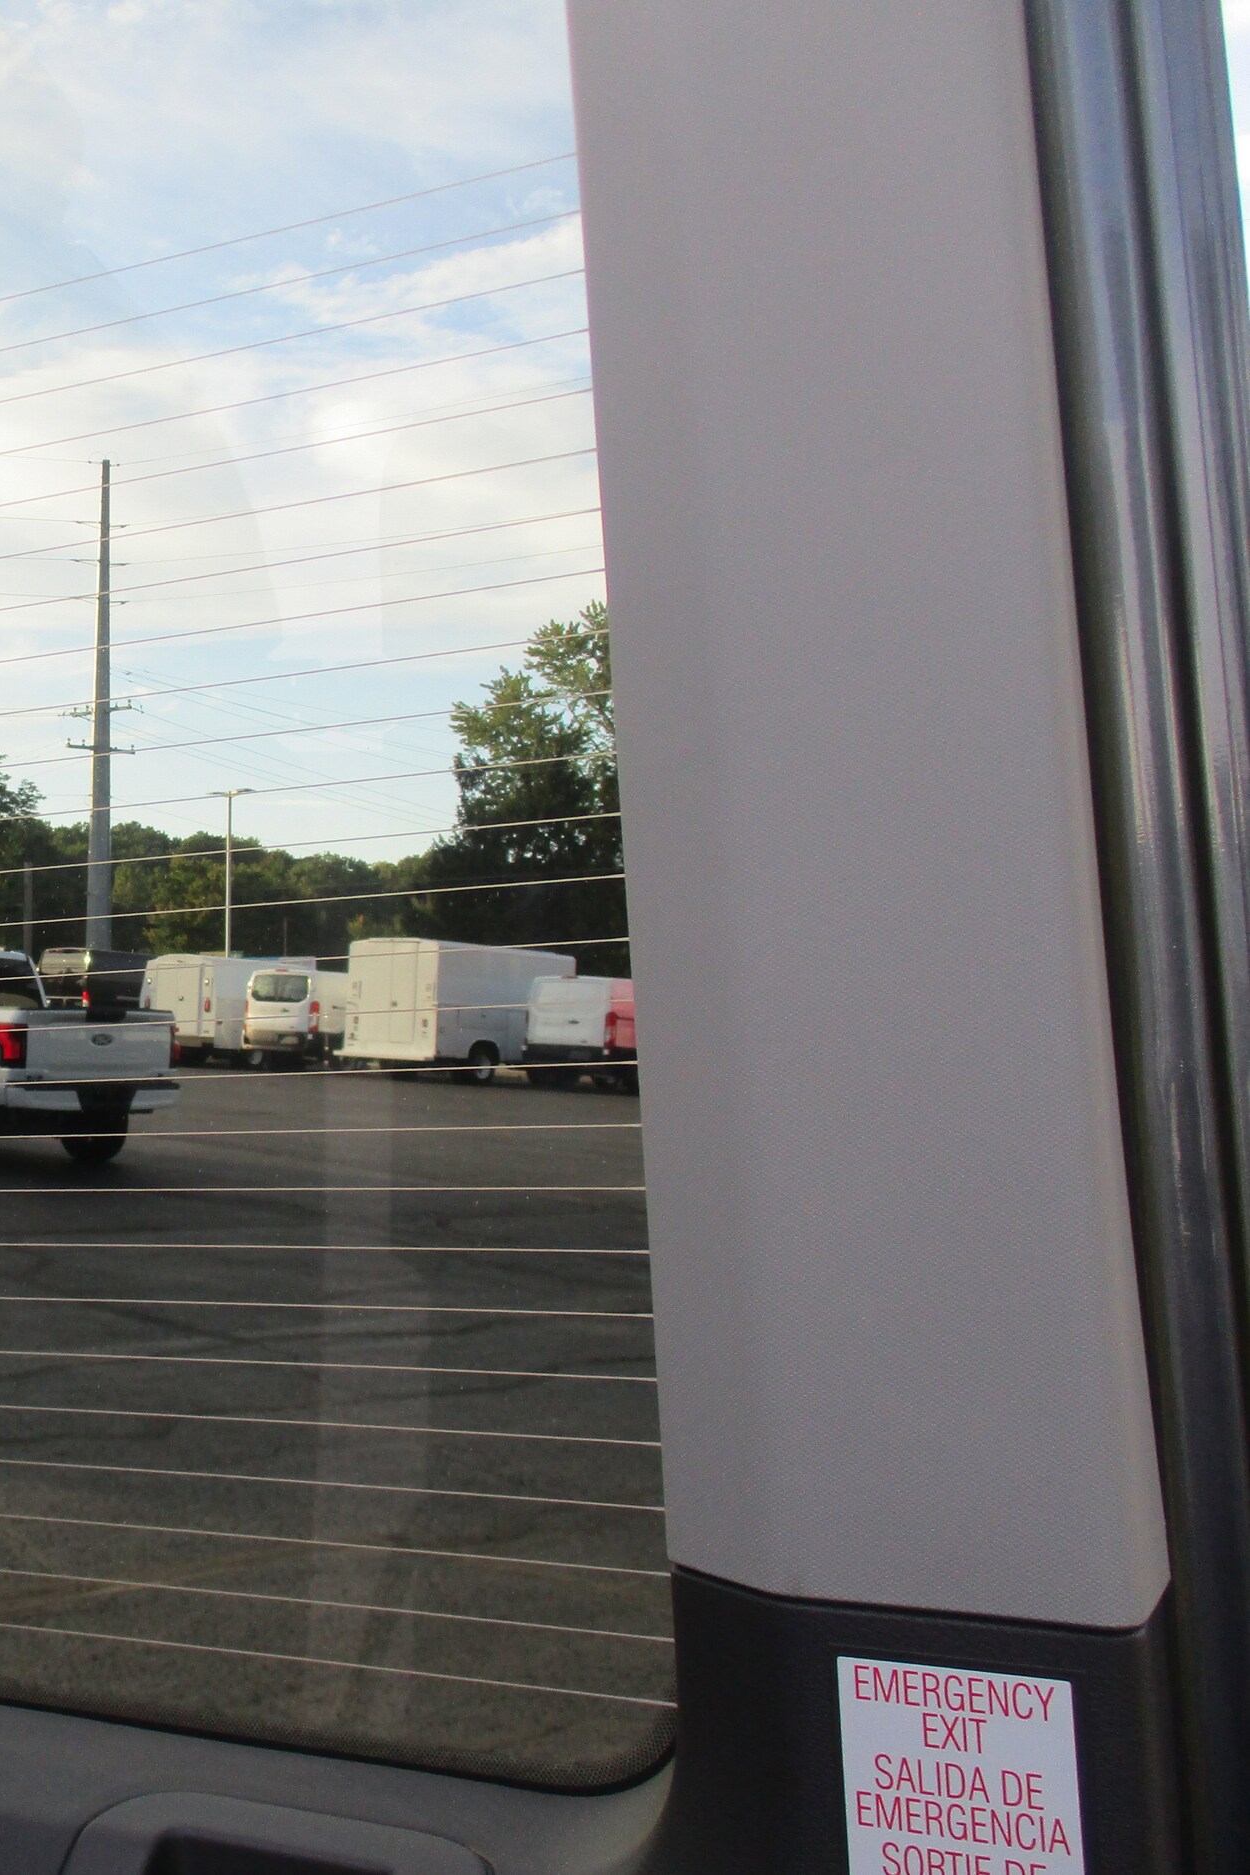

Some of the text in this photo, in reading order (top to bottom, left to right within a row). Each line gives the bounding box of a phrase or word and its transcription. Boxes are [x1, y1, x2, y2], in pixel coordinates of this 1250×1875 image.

[853, 1664, 1054, 1721] EMERGENCY
[922, 1711, 987, 1754] EXIT
[873, 1753, 1045, 1811] SALIDA DE
[855, 1790, 1071, 1856] EMERGENCIA
